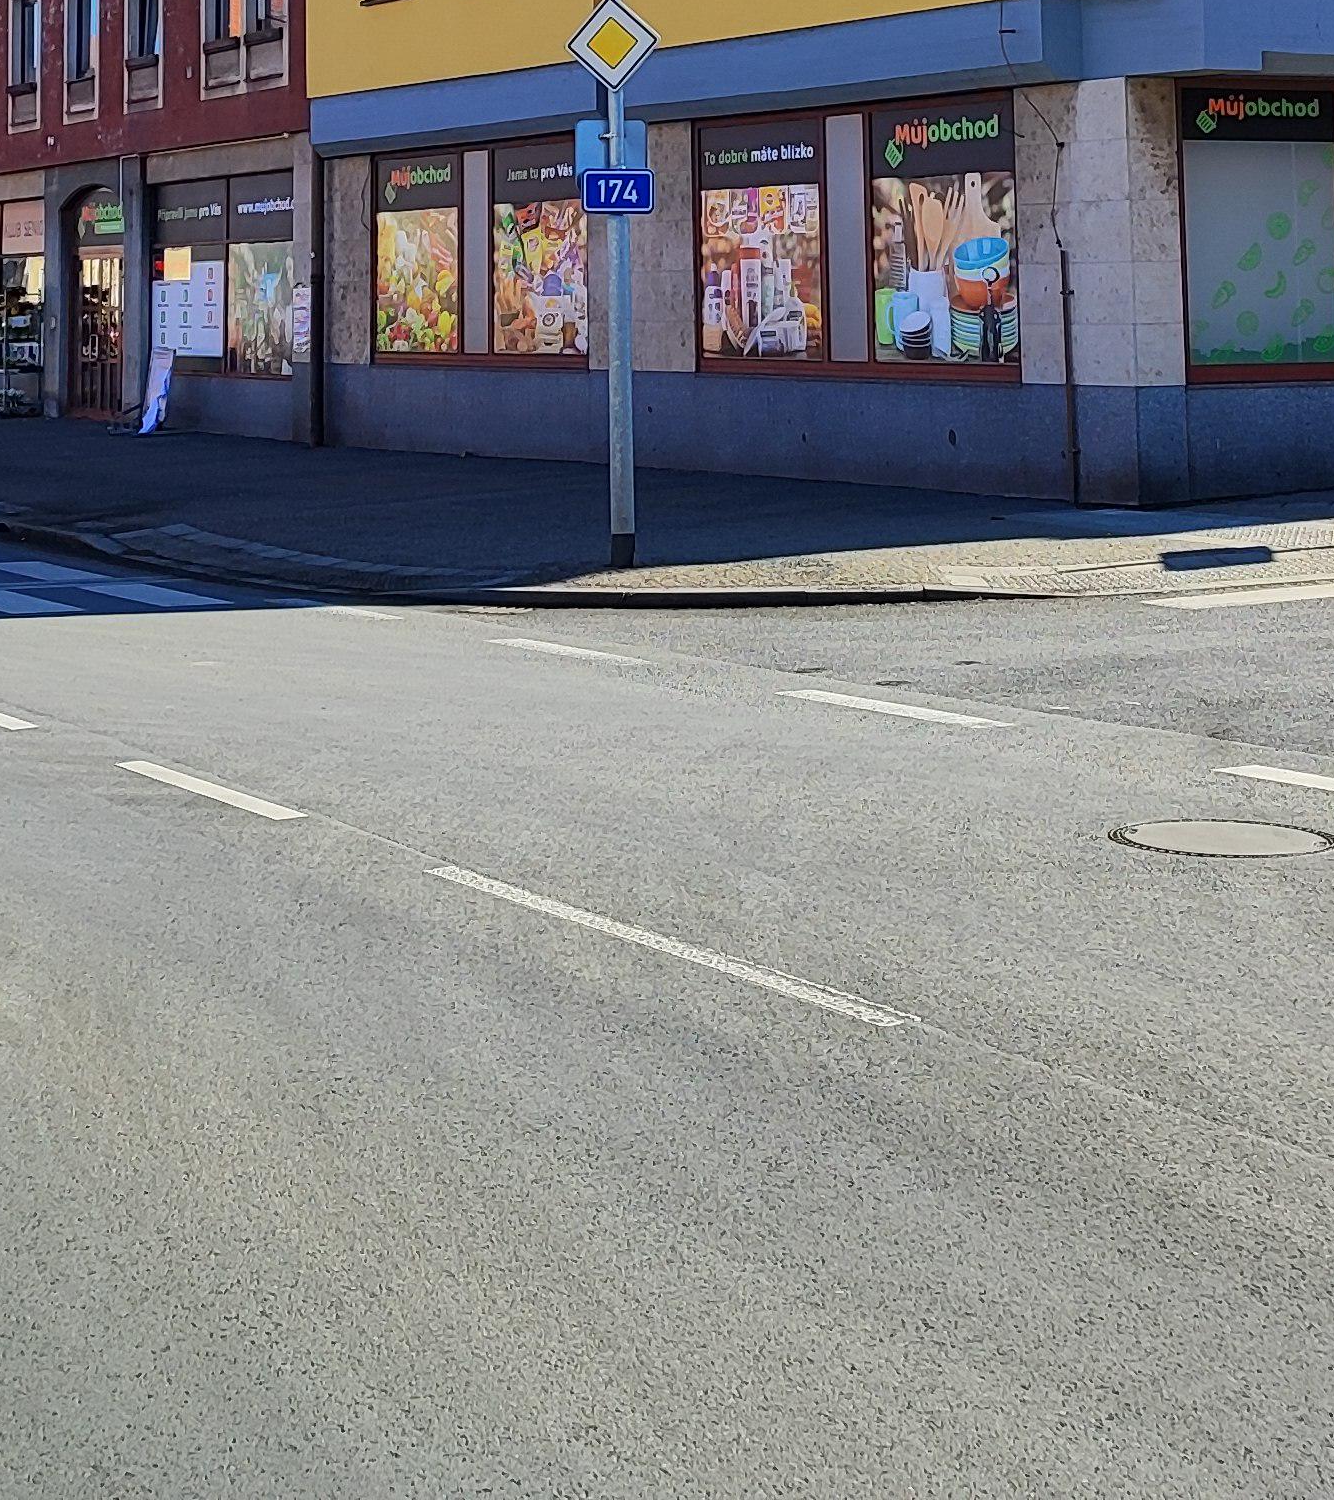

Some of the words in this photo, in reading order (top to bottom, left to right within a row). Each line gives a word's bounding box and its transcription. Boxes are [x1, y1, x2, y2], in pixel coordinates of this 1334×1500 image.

[1208, 94, 1319, 120] Můjobchod
[895, 114, 998, 149] Můjobchod
[704, 151, 716, 166] To
[718, 147, 748, 164] dobré
[750, 145, 778, 163] máte
[780, 141, 814, 160] blízko
[390, 163, 451, 190] Můjobchod
[540, 166, 555, 182] pro
[557, 161, 573, 177] Vás
[597, 179, 638, 204] 174
